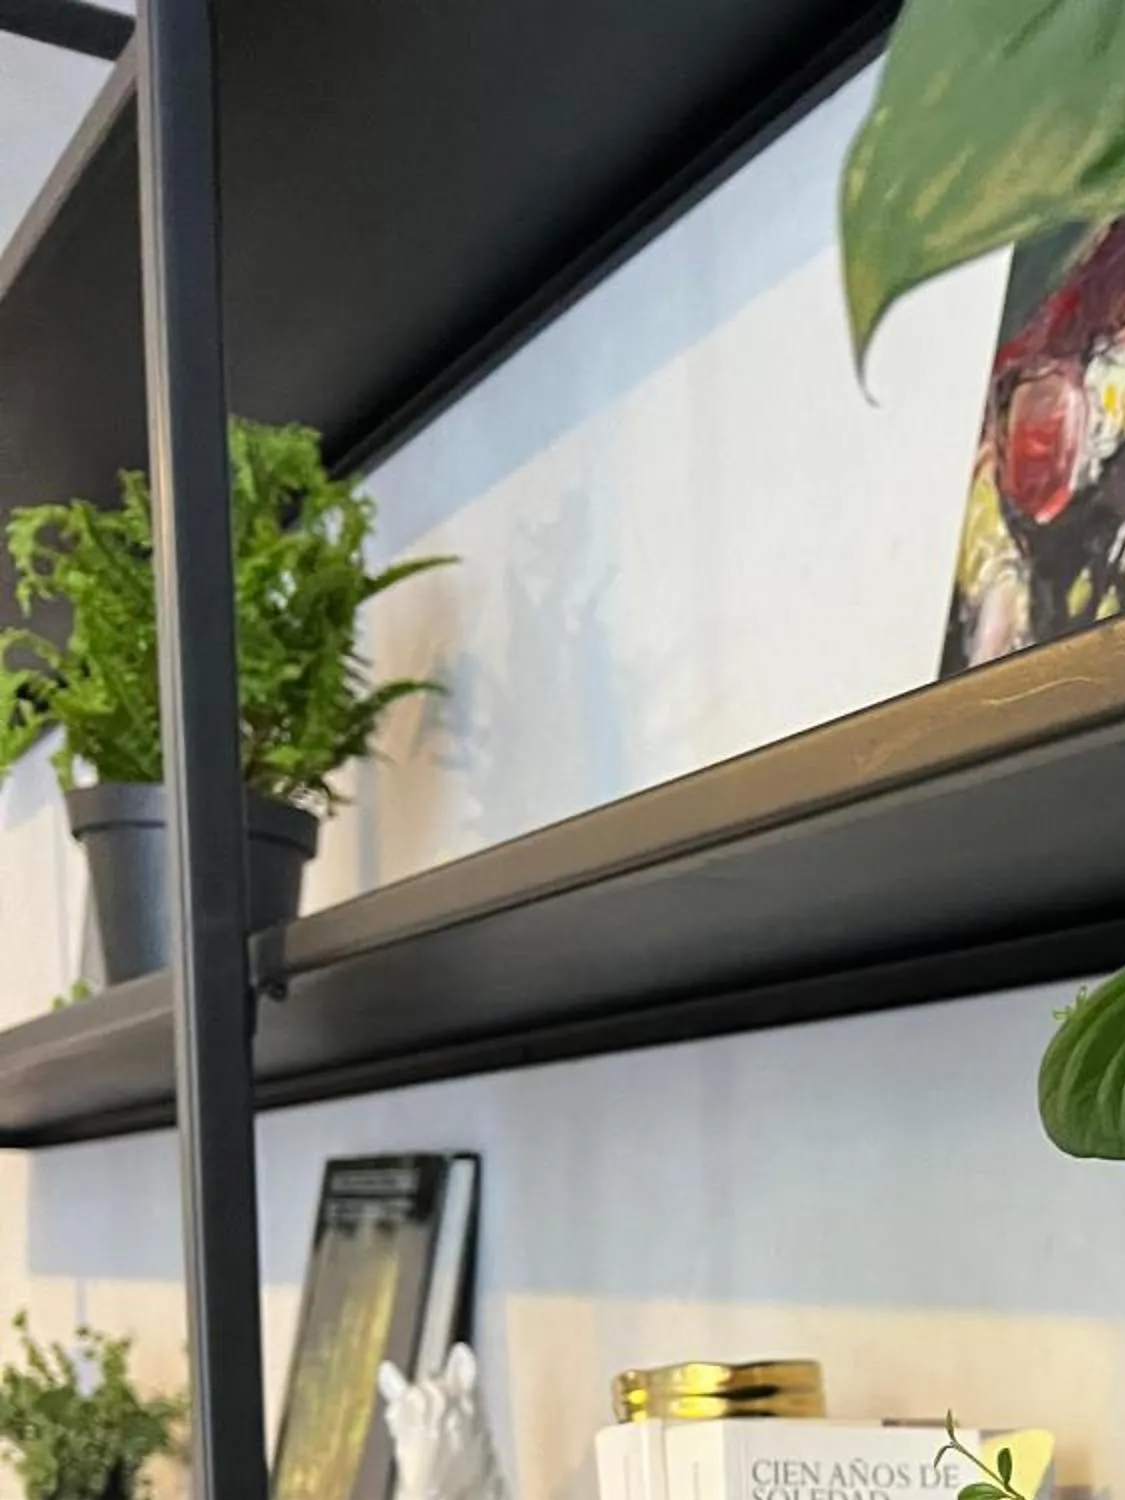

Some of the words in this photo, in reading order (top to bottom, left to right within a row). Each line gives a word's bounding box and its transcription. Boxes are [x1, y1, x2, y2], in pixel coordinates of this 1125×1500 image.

[751, 1459, 821, 1487] CIEN
[829, 1457, 912, 1488] AÑOS
[919, 1462, 960, 1488] DE
